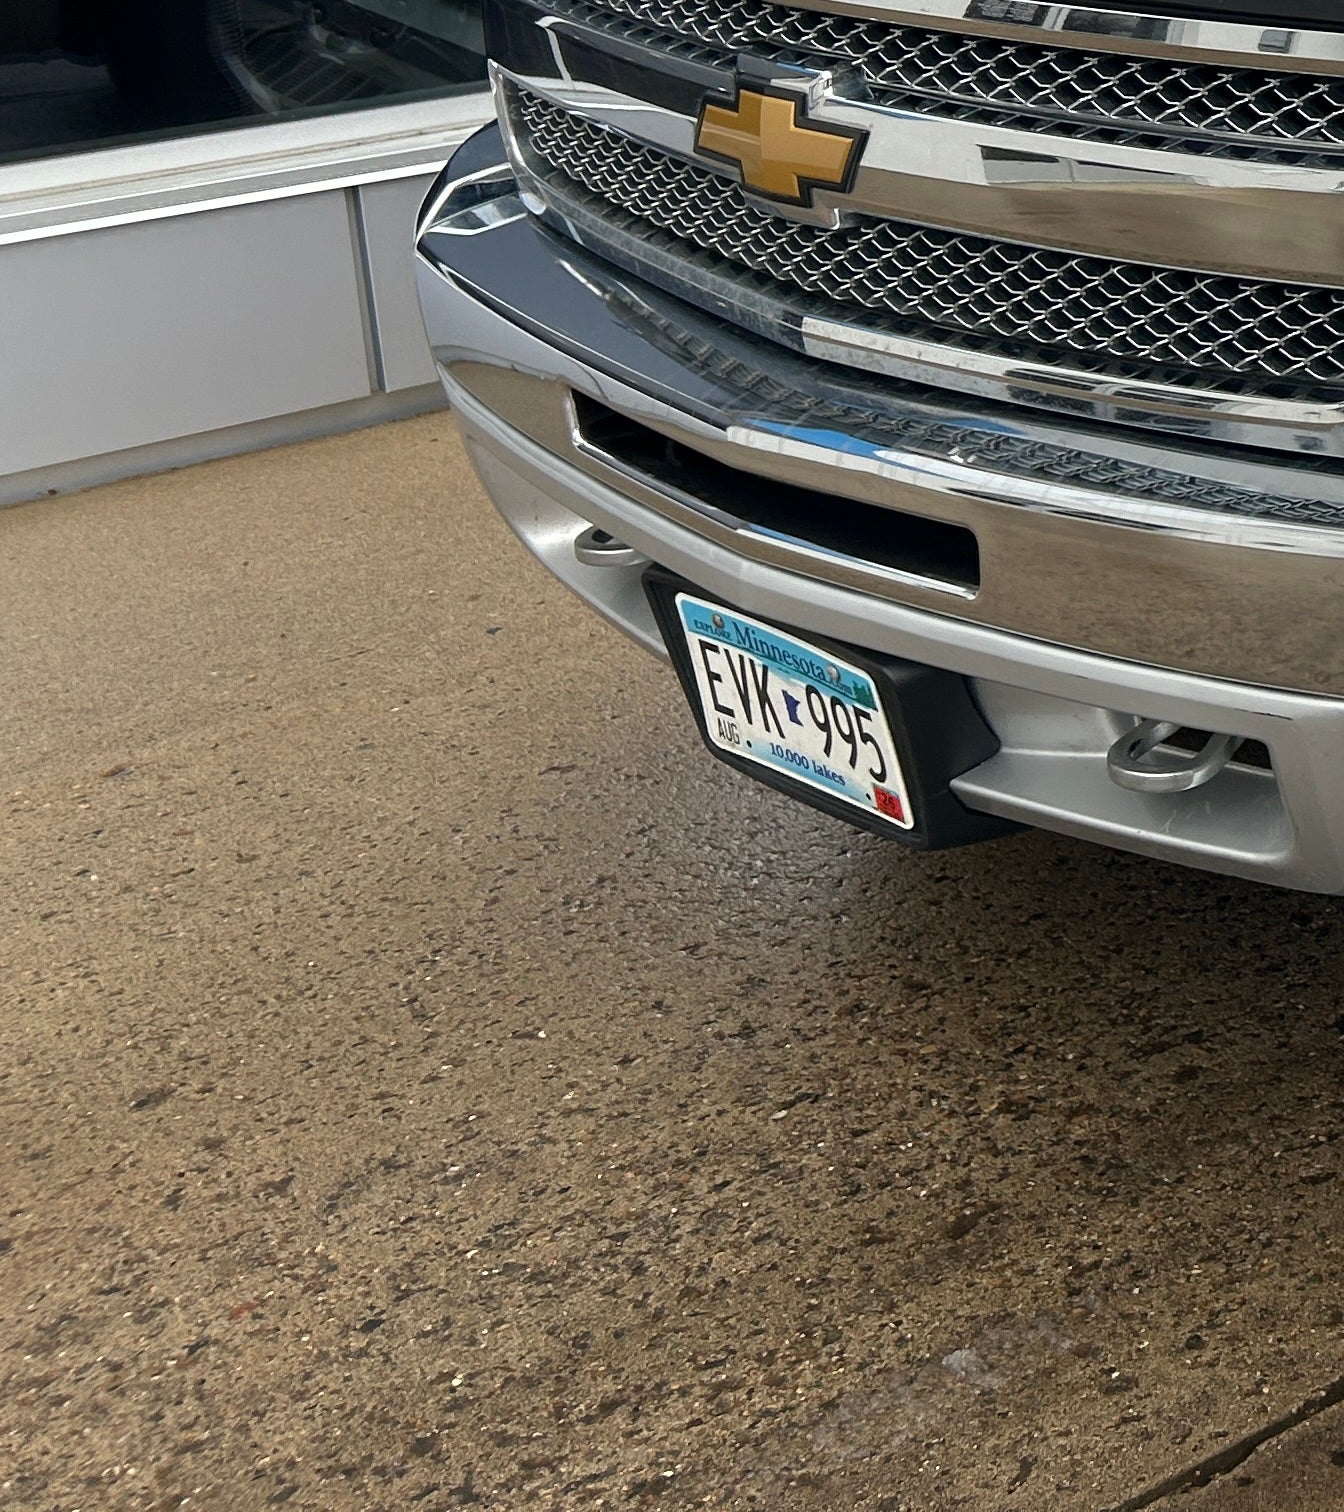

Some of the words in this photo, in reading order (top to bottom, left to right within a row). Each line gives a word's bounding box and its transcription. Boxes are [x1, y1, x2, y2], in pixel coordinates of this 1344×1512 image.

[698, 639, 786, 739] EVK
[805, 684, 888, 784] 995
[717, 717, 741, 745] AUG
[769, 742, 810, 770] 10,000
[812, 762, 846, 787] lakes
